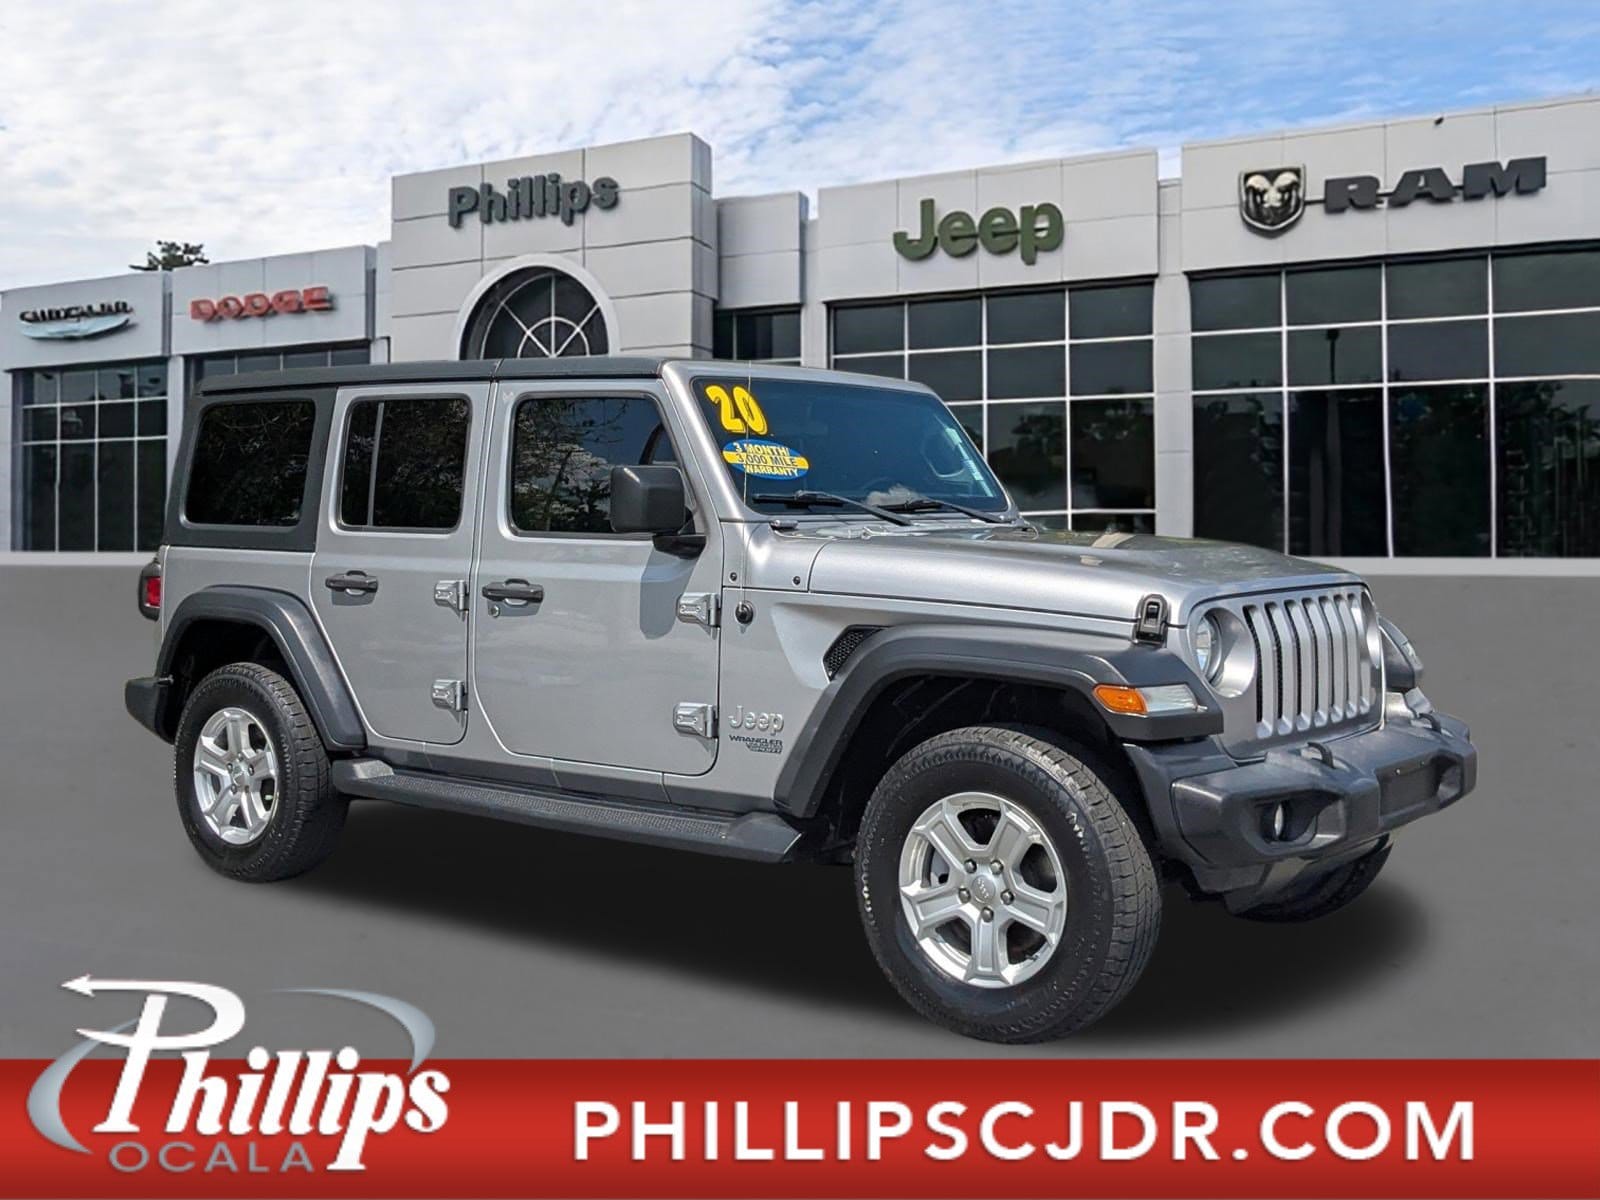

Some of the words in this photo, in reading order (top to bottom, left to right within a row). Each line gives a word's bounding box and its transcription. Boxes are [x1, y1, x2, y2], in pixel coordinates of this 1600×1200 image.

[448, 174, 620, 229] Phillips
[1324, 157, 1547, 214] RAM
[893, 199, 1065, 265] Jeep
[191, 286, 333, 321] DODGE
[705, 385, 768, 436] 20
[743, 464, 799, 477] WARRANTY
[770, 456, 796, 468] MILE
[728, 705, 784, 736] Jeep
[729, 735, 783, 746] WRANGLER
